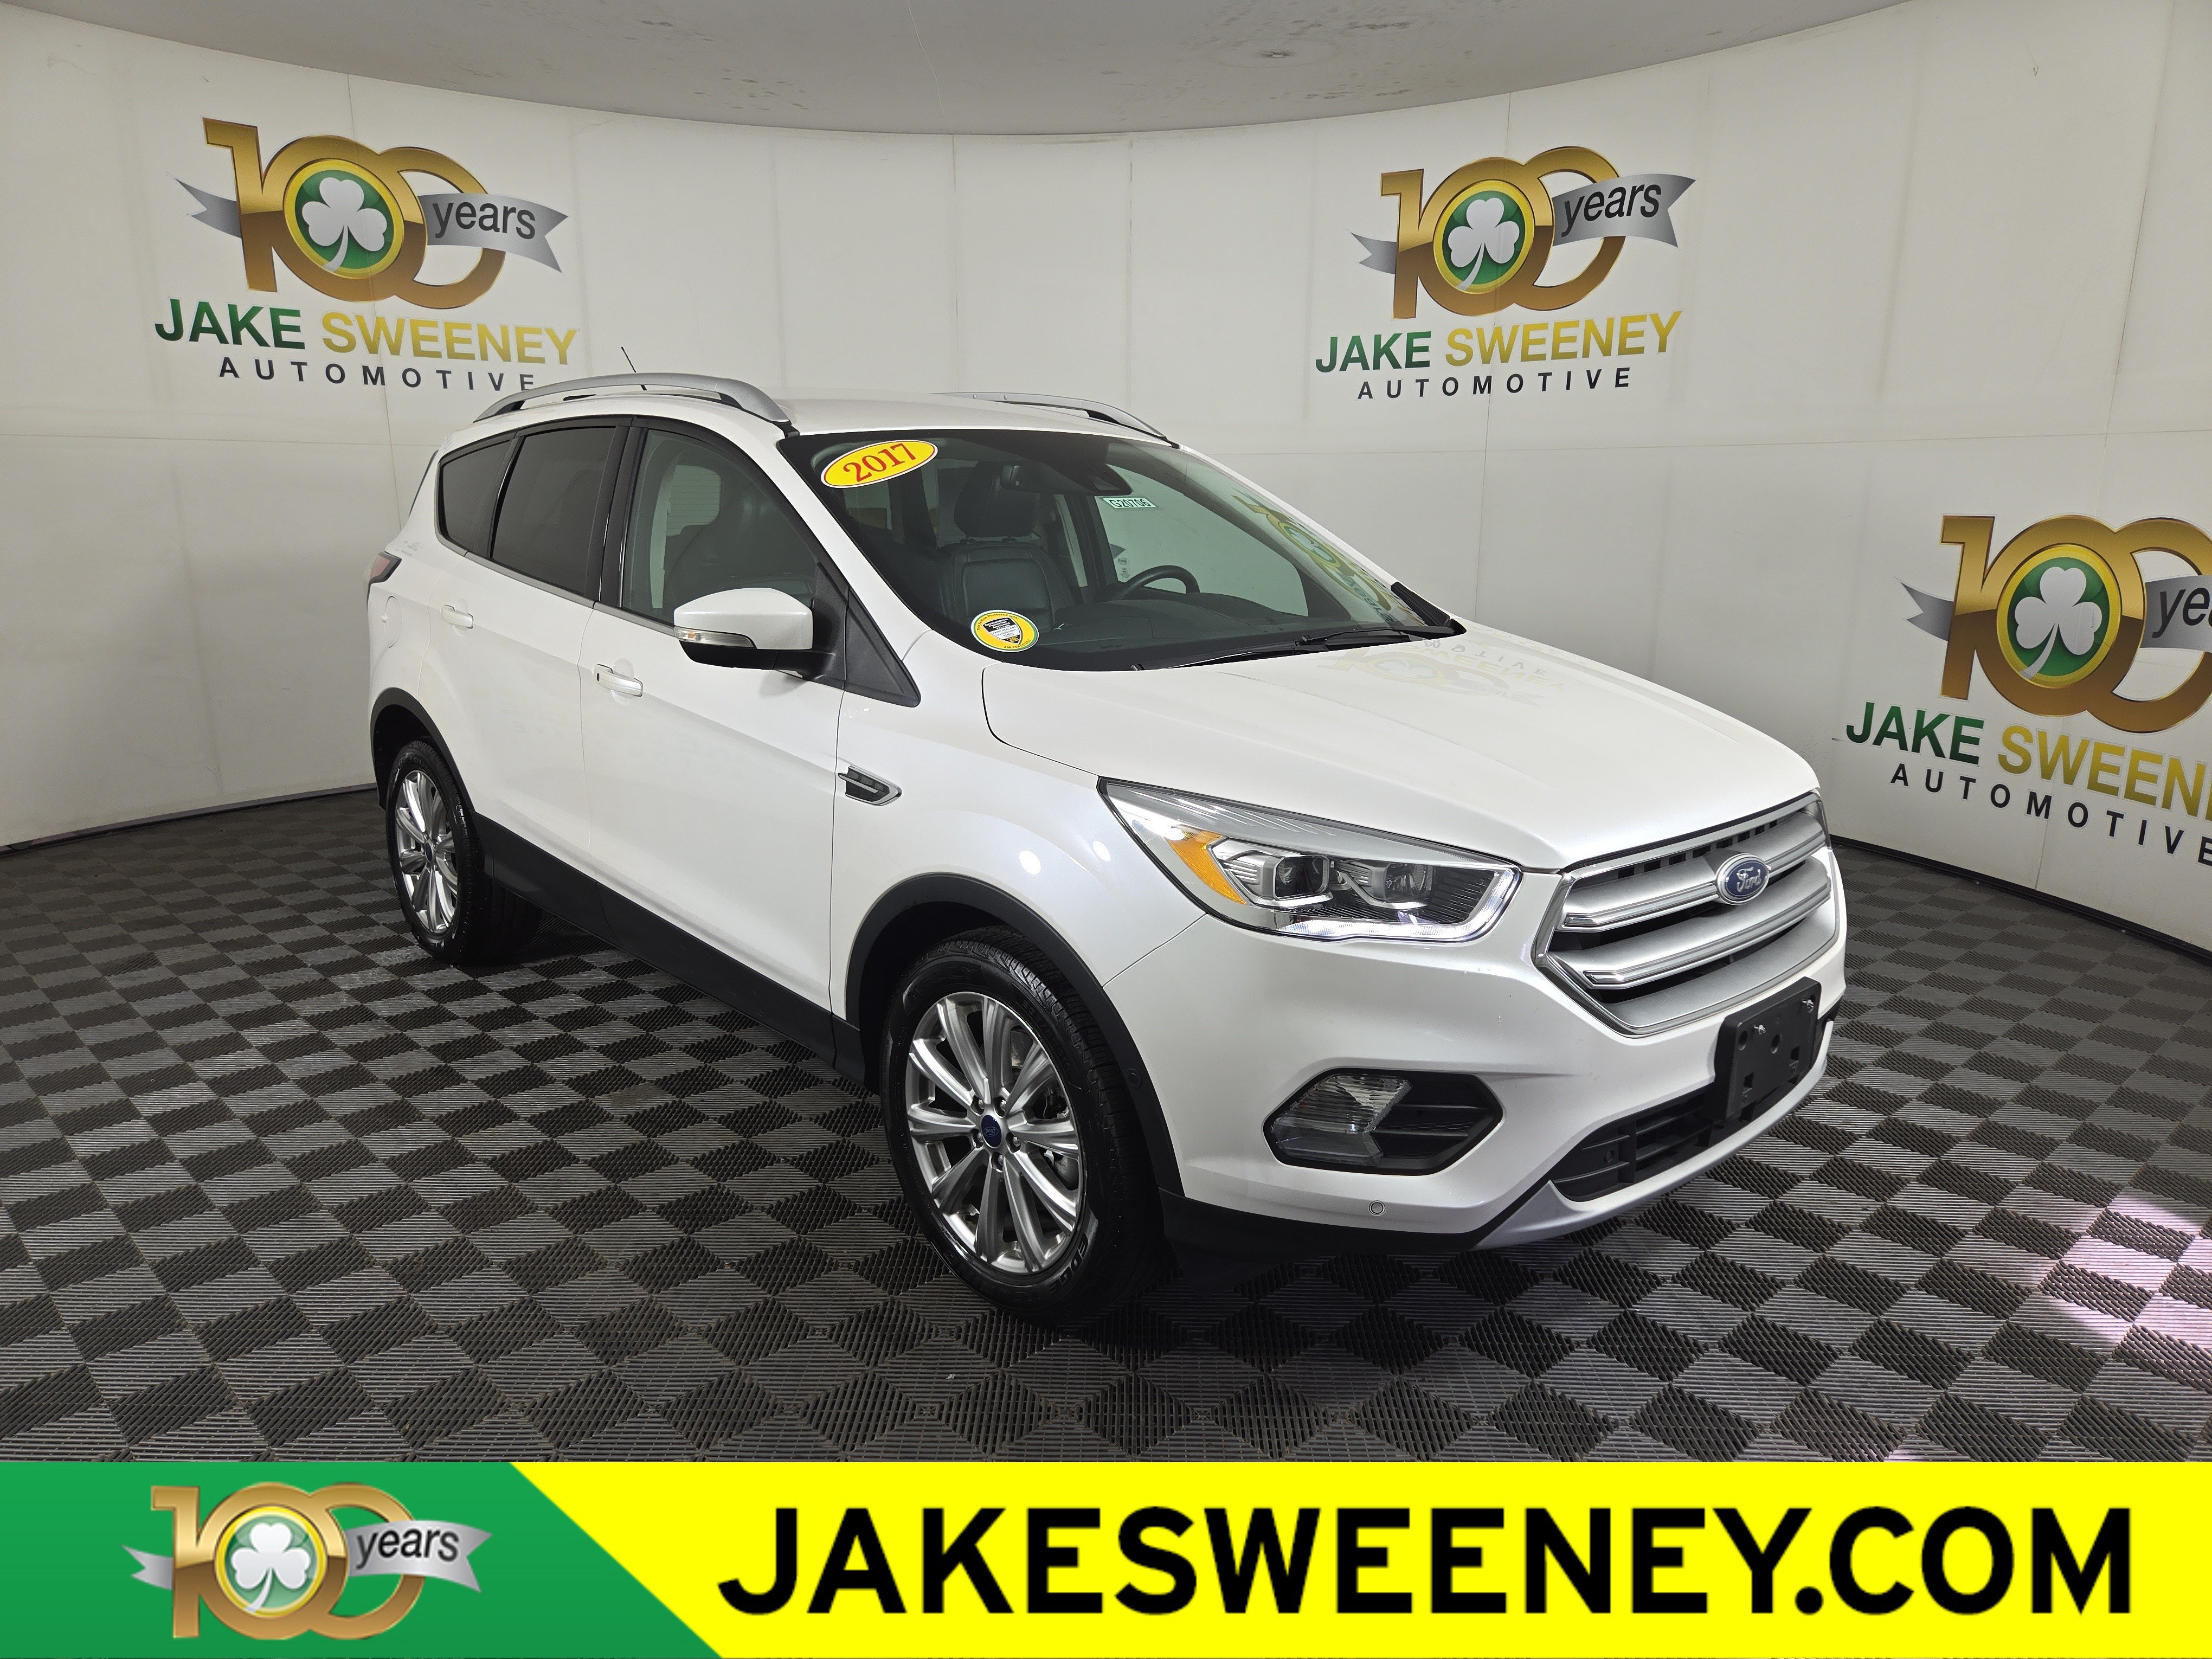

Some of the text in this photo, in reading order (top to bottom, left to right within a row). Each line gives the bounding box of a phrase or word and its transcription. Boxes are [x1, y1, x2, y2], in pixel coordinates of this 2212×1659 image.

[202, 118, 536, 309] 100 years
[1381, 146, 1662, 319] 100 years
[154, 298, 578, 365] JAKE SWEENEY
[1315, 311, 1682, 373] JAKE SWEENEY
[219, 357, 535, 391] AUTOMOTIVE
[1357, 367, 1630, 400] AUTOMOTIVE
[843, 443, 917, 483] 2017
[1109, 499, 1151, 507] G20706
[1846, 702, 1984, 765] JAKE
[1737, 867, 1762, 892] Ford
